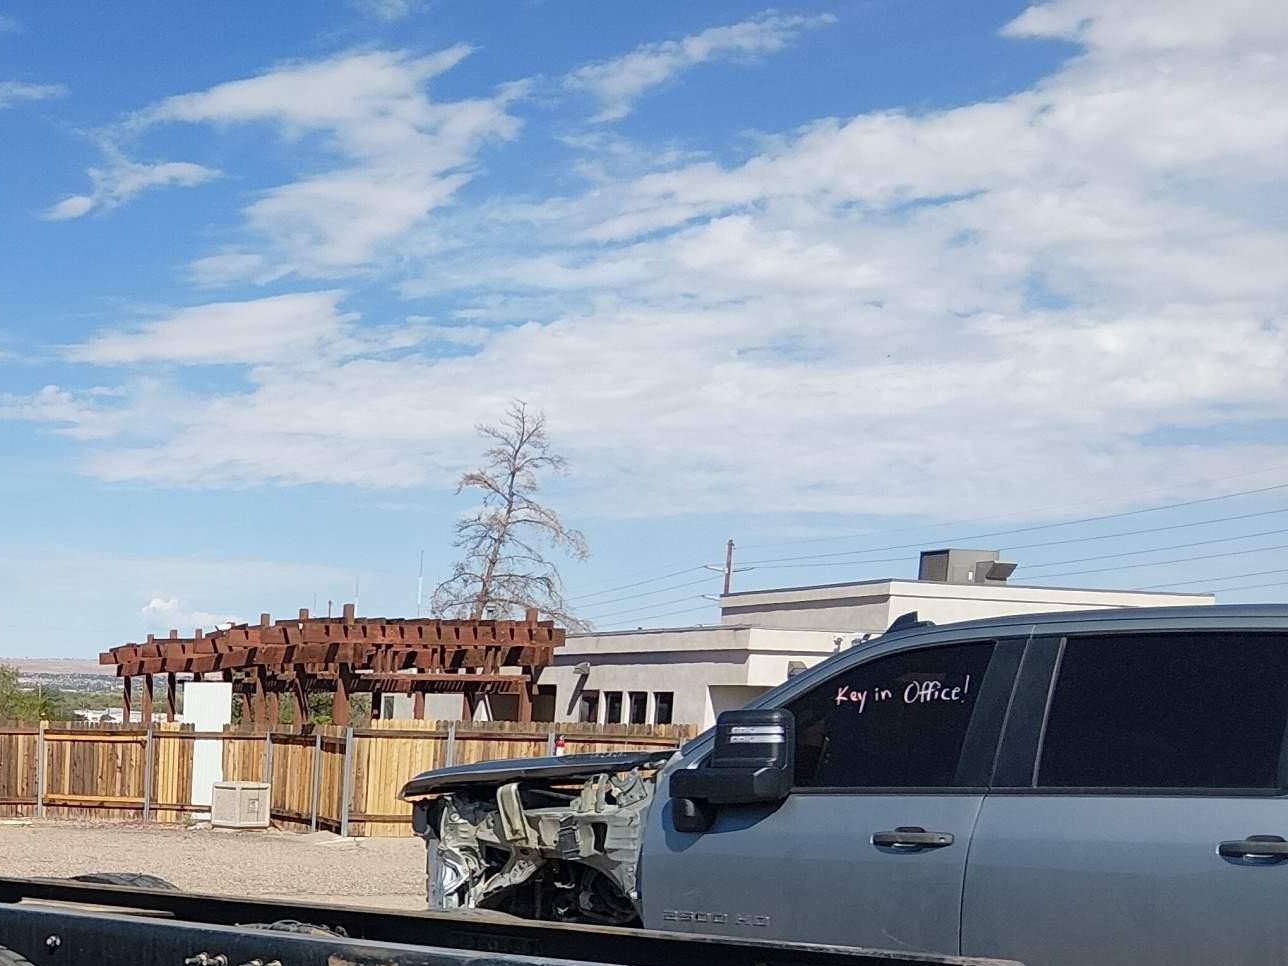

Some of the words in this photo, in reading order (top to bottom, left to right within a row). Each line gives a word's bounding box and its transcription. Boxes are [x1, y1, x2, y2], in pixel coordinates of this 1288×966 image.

[834, 685, 868, 714] Key
[874, 687, 893, 701] in
[903, 674, 970, 704] Office!
